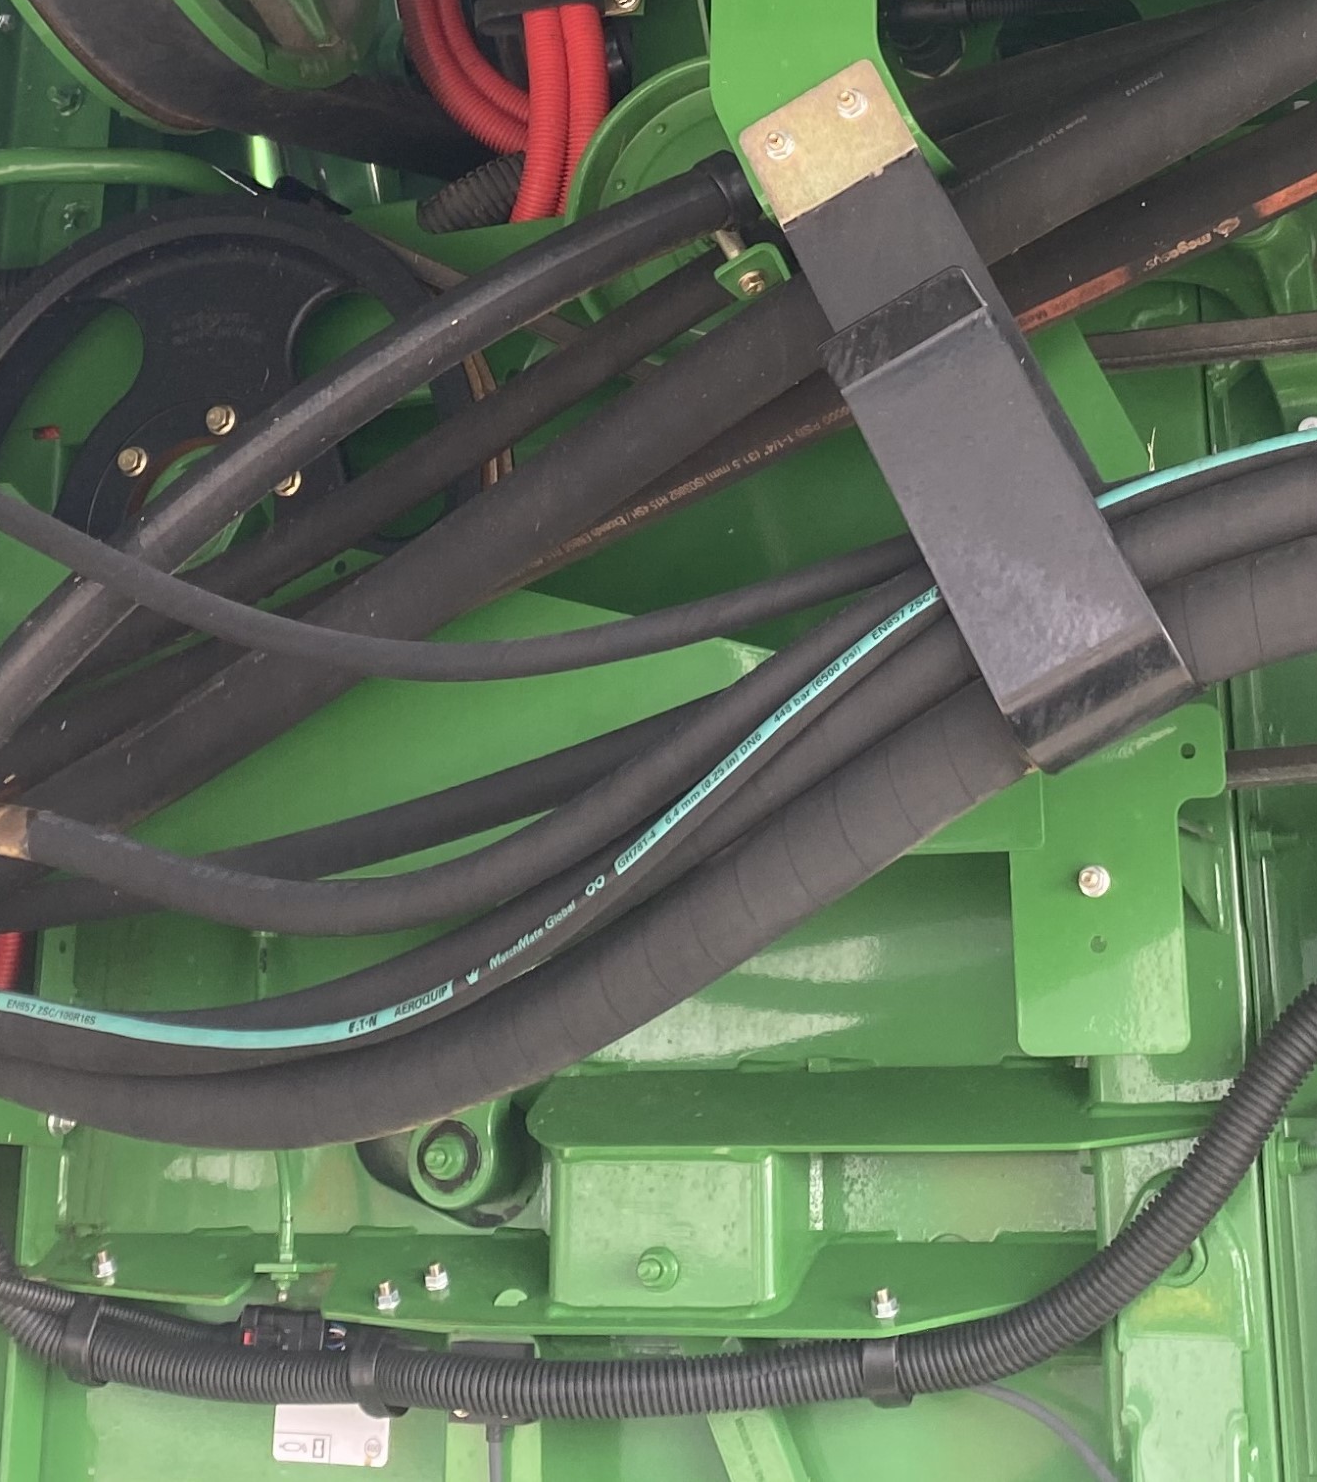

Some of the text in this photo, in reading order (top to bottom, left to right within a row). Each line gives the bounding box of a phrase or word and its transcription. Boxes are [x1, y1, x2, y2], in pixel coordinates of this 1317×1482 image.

[392, 984, 450, 1018] AEROQUIP
[488, 927, 544, 971] MatchMate
[544, 899, 577, 930] Global
[613, 828, 659, 869] GH781-4
[662, 807, 681, 825] 6.4
[678, 789, 702, 810] mm
[698, 765, 727, 792] (0.25
[722, 752, 740, 769] in)
[737, 731, 764, 756] DN6
[771, 703, 793, 724] 448
[791, 687, 812, 706] bar
[809, 661, 842, 691] (6500
[870, 609, 907, 641] EN857
